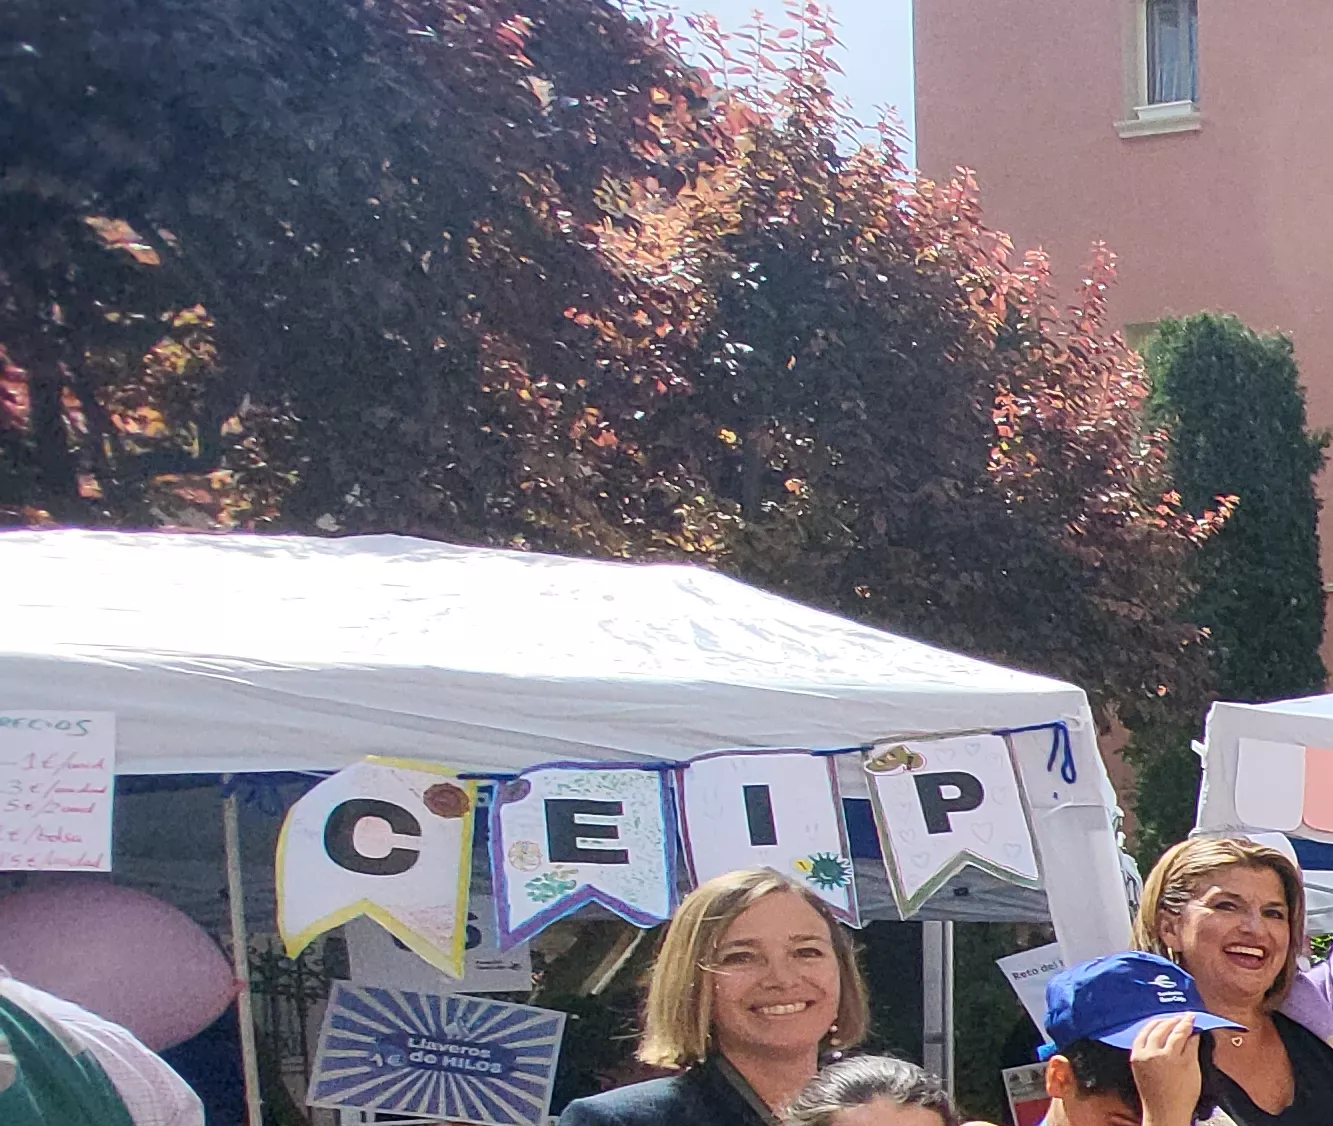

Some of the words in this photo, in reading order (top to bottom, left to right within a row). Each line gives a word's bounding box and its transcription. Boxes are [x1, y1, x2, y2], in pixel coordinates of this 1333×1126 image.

[1012, 967, 1039, 981] Reto
[407, 1037, 491, 1058] Llaveros
[409, 1051, 437, 1065] de
[442, 1055, 503, 1074] HILOS
